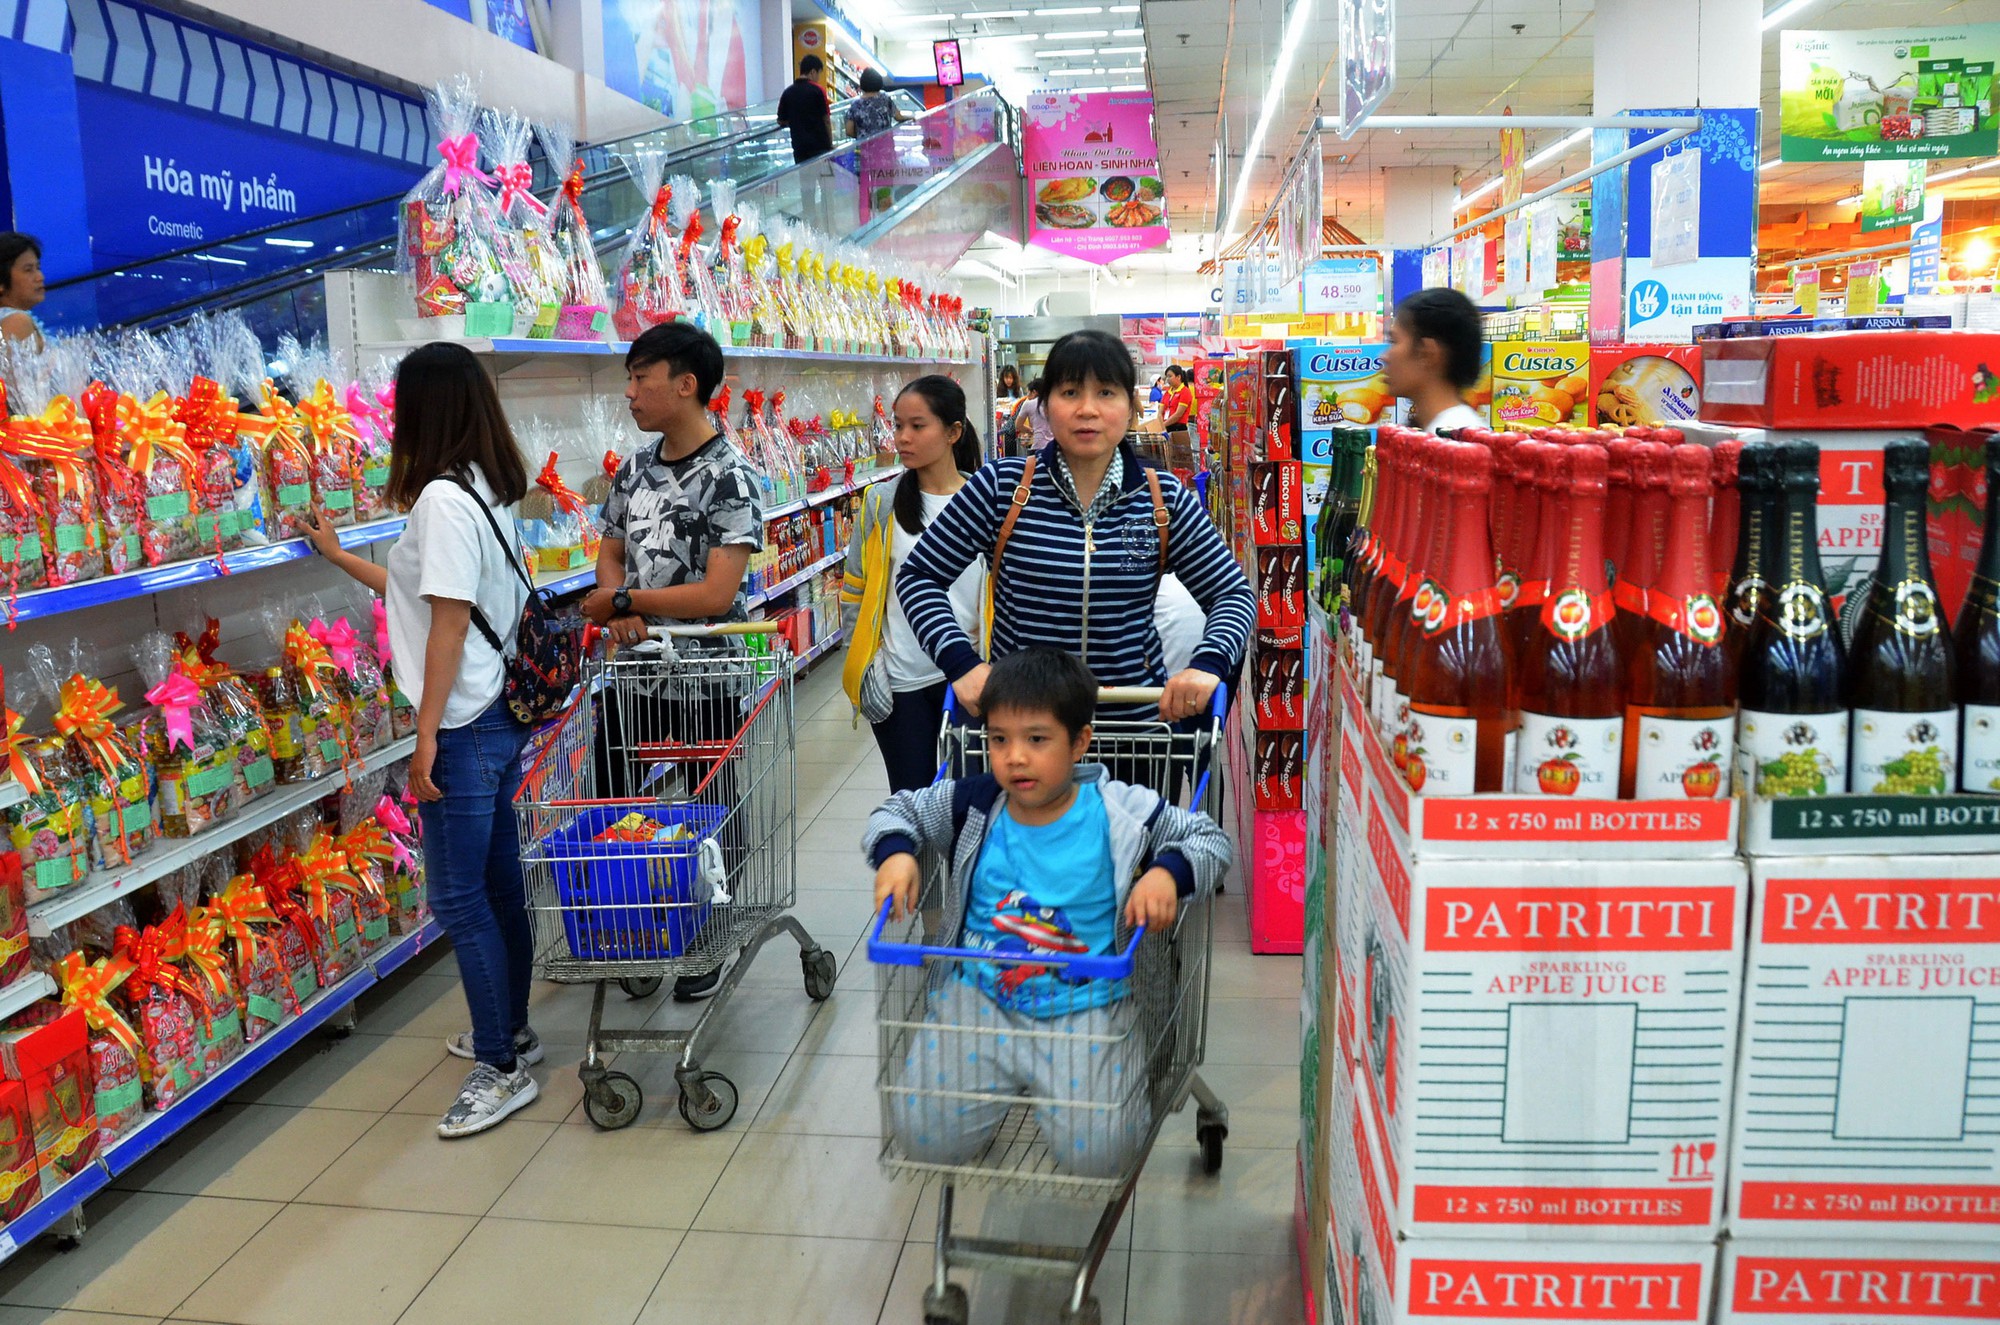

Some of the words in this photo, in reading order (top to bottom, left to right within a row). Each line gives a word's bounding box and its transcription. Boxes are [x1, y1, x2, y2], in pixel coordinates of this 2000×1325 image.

[1100, 159, 1128, 169] SINH
[144, 154, 195, 197] Hóa
[200, 169, 233, 211] mỹ
[239, 172, 297, 214] phẩm
[148, 215, 204, 240] Cosmetic
[1640, 303, 1654, 313] 3T
[1698, 291, 1723, 302] ĐỘNG
[1671, 303, 1692, 317] tận
[1697, 303, 1722, 315] tâm
[1768, 325, 1808, 336] ARSENAL
[1865, 318, 1906, 328] ARSENAL
[1310, 353, 1385, 374] Custas
[1504, 352, 1576, 373] Custas
[1662, 386, 1696, 417] Arsenal
[1281, 465, 1290, 519] CHOCO-PIE
[1257, 491, 1269, 533] CHOCO-PIE
[1790, 511, 1804, 580] PATRITTI
[1904, 510, 1920, 581] PATRITTI
[1262, 575, 1273, 616] CHOCO-PIE
[1285, 574, 1296, 615] CHOCO-PIE
[1262, 678, 1273, 719] CHOCO-PIE
[1284, 678, 1296, 718] CHOCO-PIE
[1260, 759, 1271, 799] CHOCO-PIE
[1282, 759, 1294, 799] CHOCO-PIE
[1454, 812, 1478, 830] 12
[1486, 816, 1499, 830] x
[1507, 812, 1547, 830] 750
[1553, 811, 1582, 830] ml
[1589, 812, 1702, 831] BOTTLES
[1799, 809, 1824, 829] 12
[1830, 813, 1845, 828] x
[1851, 807, 1892, 828] 750
[1897, 806, 1927, 826] ml
[1933, 804, 2000, 824] BOTT
[1443, 901, 1715, 938] PATRITTI
[1781, 893, 2000, 931] PATRIT
[1528, 961, 1627, 974] SPARKLING
[1865, 953, 1966, 966] SPARKLING
[1486, 975, 1574, 994] APPLE
[1583, 974, 1667, 998] JUICE
[1823, 967, 1910, 987] APPLE
[1919, 967, 2000, 991] JUICE
[1445, 1197, 1468, 1214] 12
[1475, 1201, 1488, 1214] x
[1496, 1198, 1534, 1215] 750
[1540, 1198, 1567, 1215] ml
[1574, 1199, 1683, 1216] BOTTLES
[1772, 1193, 1796, 1210] 12
[1803, 1197, 1816, 1211] x
[1823, 1193, 1863, 1211] 750
[1869, 1194, 1897, 1212] ml
[1904, 1195, 2000, 1214] BOTTLE
[1425, 1271, 1683, 1310] PATRITTI
[1749, 1268, 2000, 1307] PATRITT
